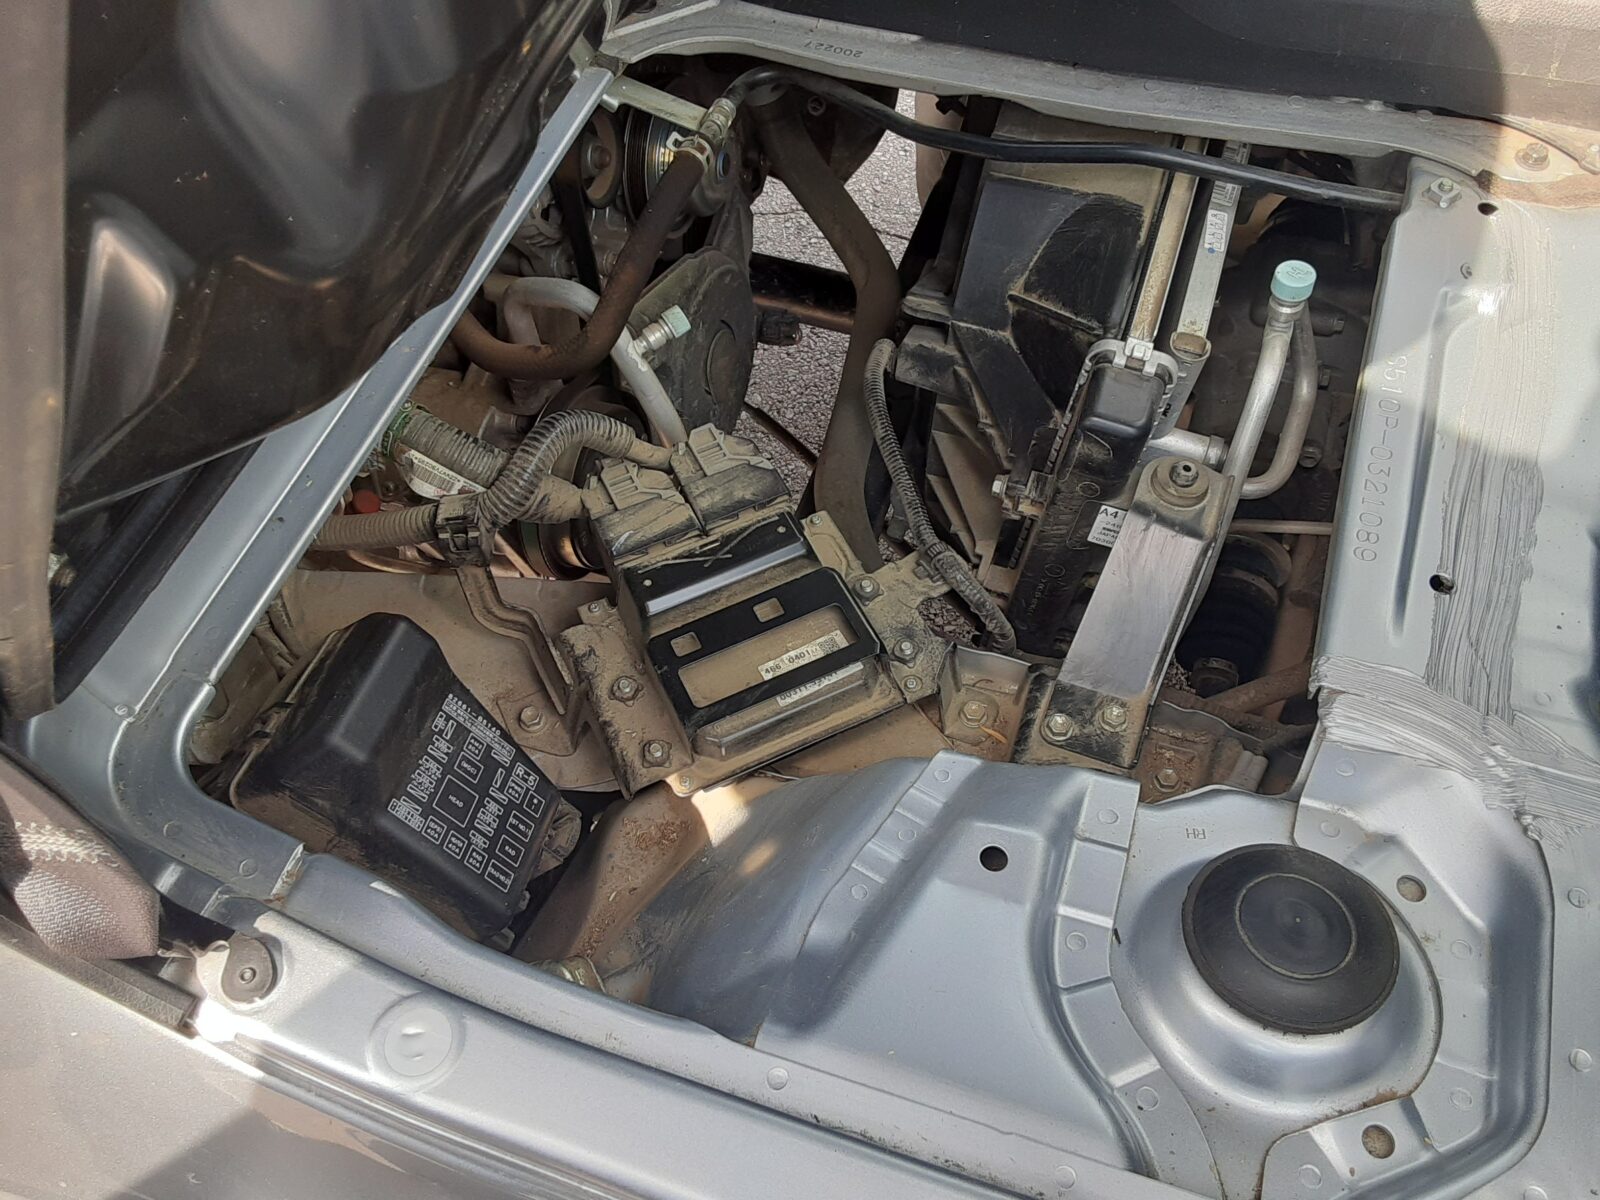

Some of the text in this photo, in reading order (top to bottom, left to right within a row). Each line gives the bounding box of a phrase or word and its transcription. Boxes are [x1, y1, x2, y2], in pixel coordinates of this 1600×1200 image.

[803, 40, 864, 58] 200227
[1099, 507, 1119, 519] A4
[514, 766, 536, 786] R-5
[448, 794, 463, 808] HEAD
[426, 827, 439, 839] 40A
[428, 820, 442, 834] (EPS)
[1185, 827, 1206, 840] RH
[447, 842, 459, 854] 40A
[504, 845, 516, 856] RAD
[471, 851, 483, 862] RAD
